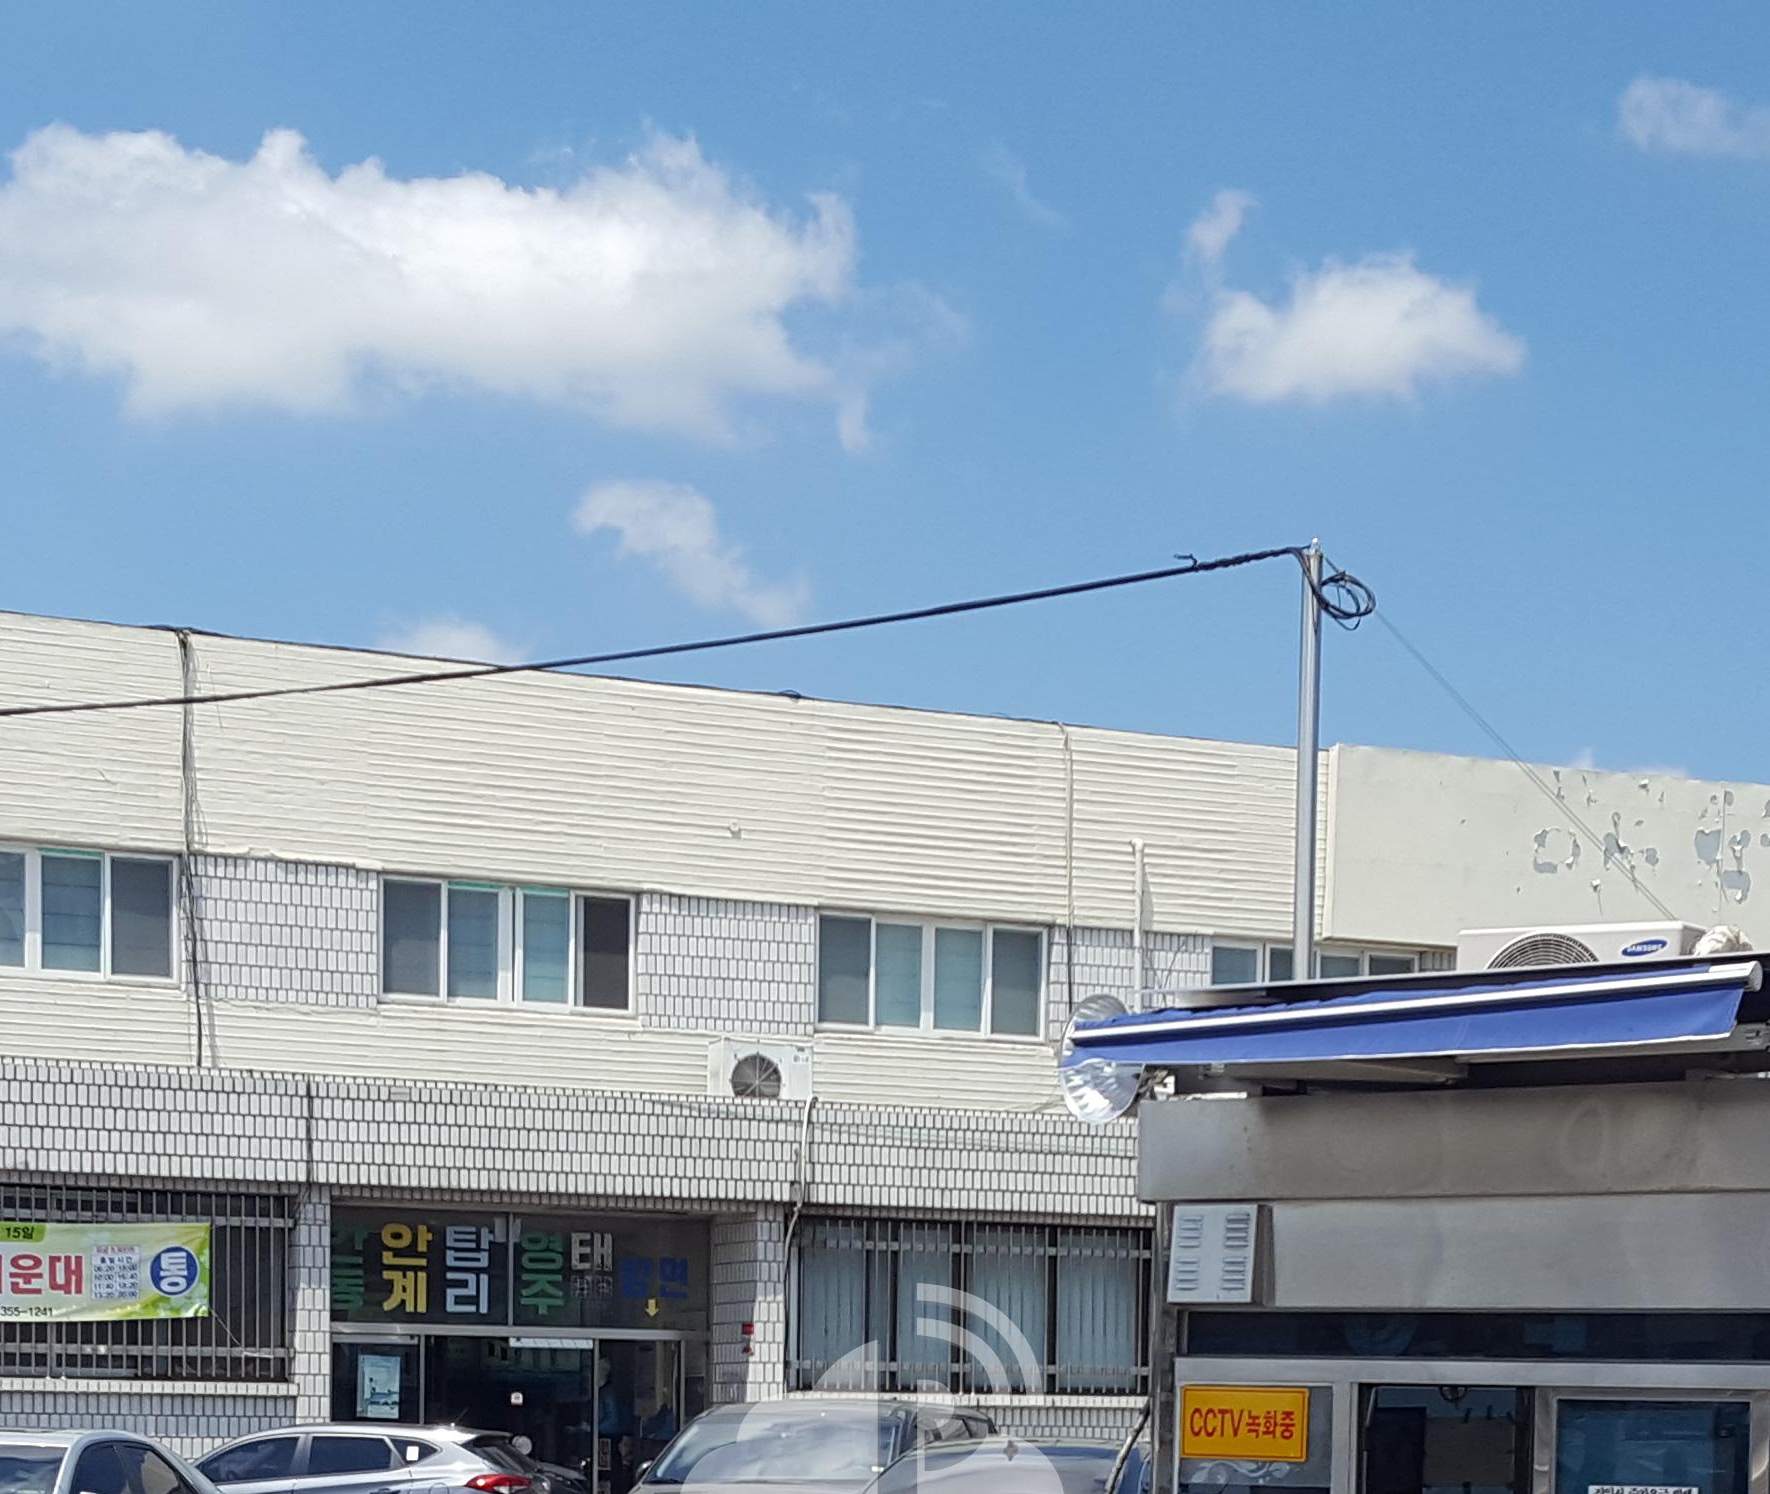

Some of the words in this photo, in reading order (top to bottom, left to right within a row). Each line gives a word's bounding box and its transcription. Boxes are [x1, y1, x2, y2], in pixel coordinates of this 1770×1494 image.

[5, 1226, 35, 1240] 15일
[159, 1251, 188, 1293] 통
[380, 1222, 435, 1313] 안계
[444, 1226, 495, 1314] 탑리
[520, 1231, 565, 1315] 영주
